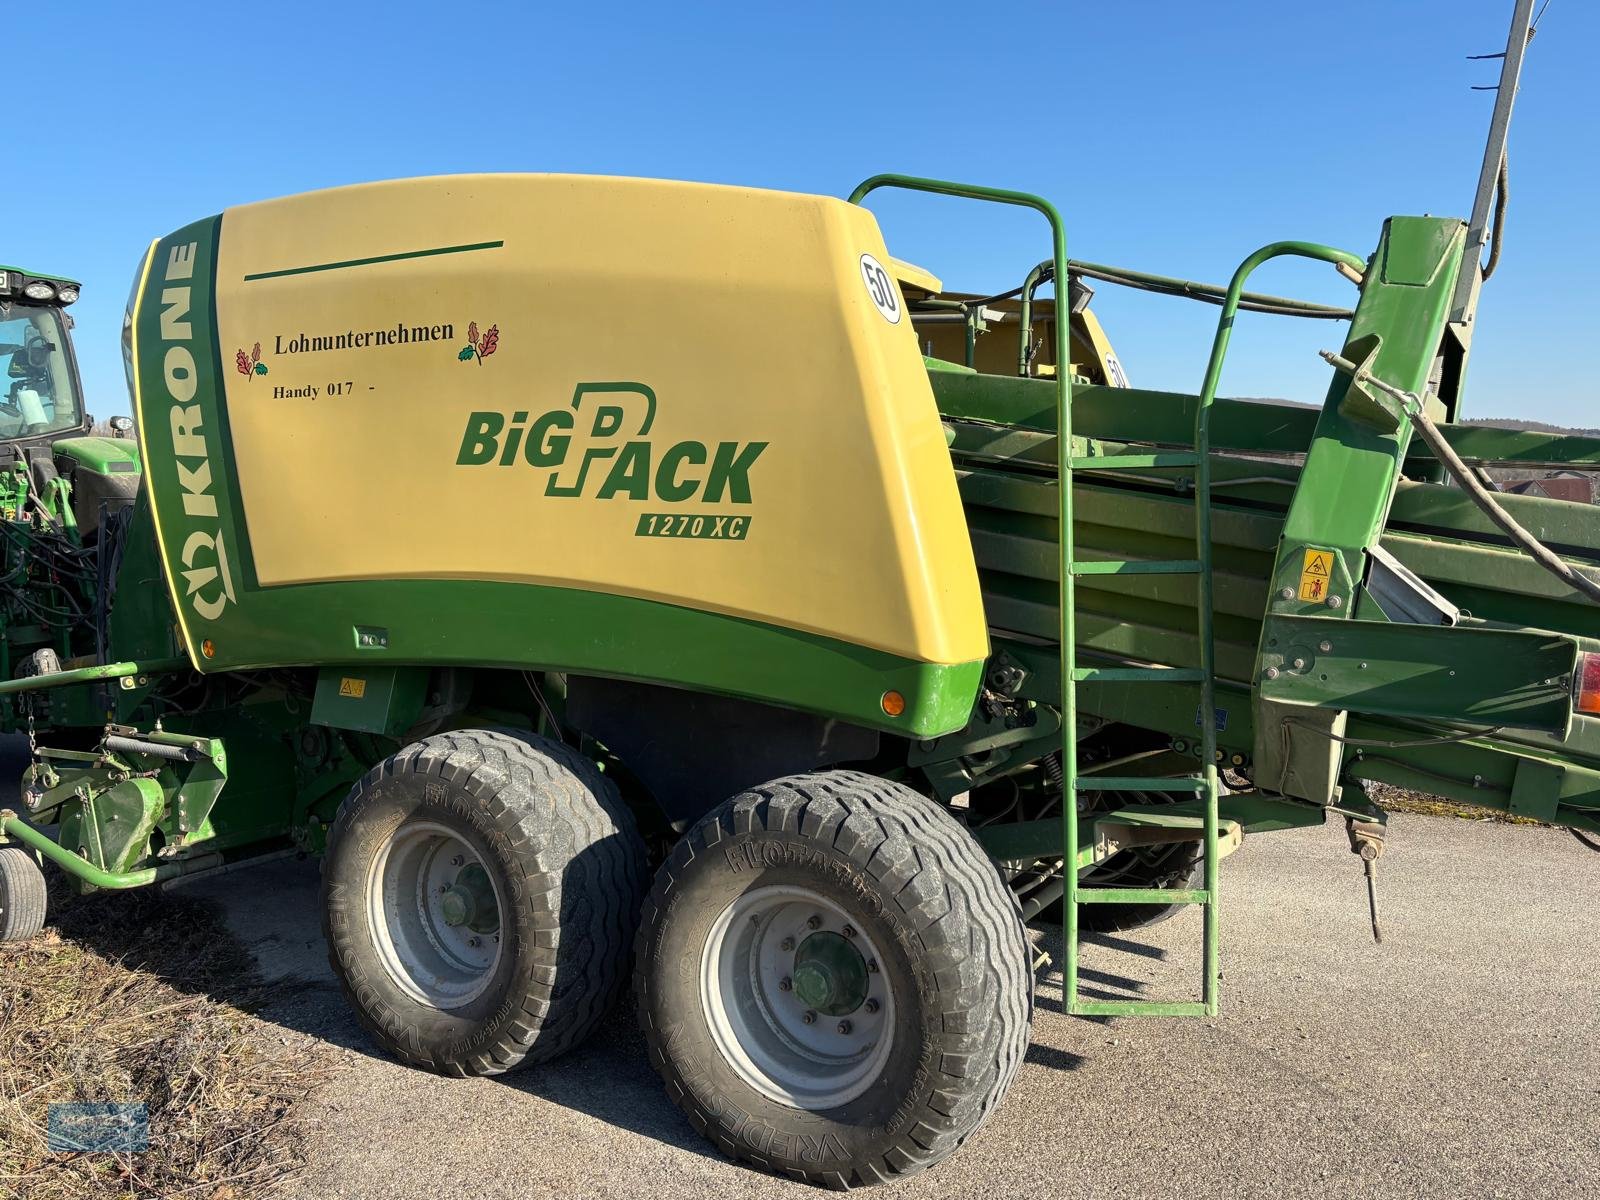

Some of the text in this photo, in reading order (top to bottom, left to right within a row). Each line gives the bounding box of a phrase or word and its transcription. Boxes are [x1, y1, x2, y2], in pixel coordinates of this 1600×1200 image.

[863, 262, 896, 311] 50
[275, 323, 454, 355] Lohnunternehmen
[160, 241, 218, 517] KRONE
[273, 385, 320, 400] Handy
[327, 382, 353, 396] 017
[648, 516, 744, 538] 1270 XC
[328, 880, 422, 1053] VREDESTEIN
[666, 1022, 853, 1163] VREDESTEIN
